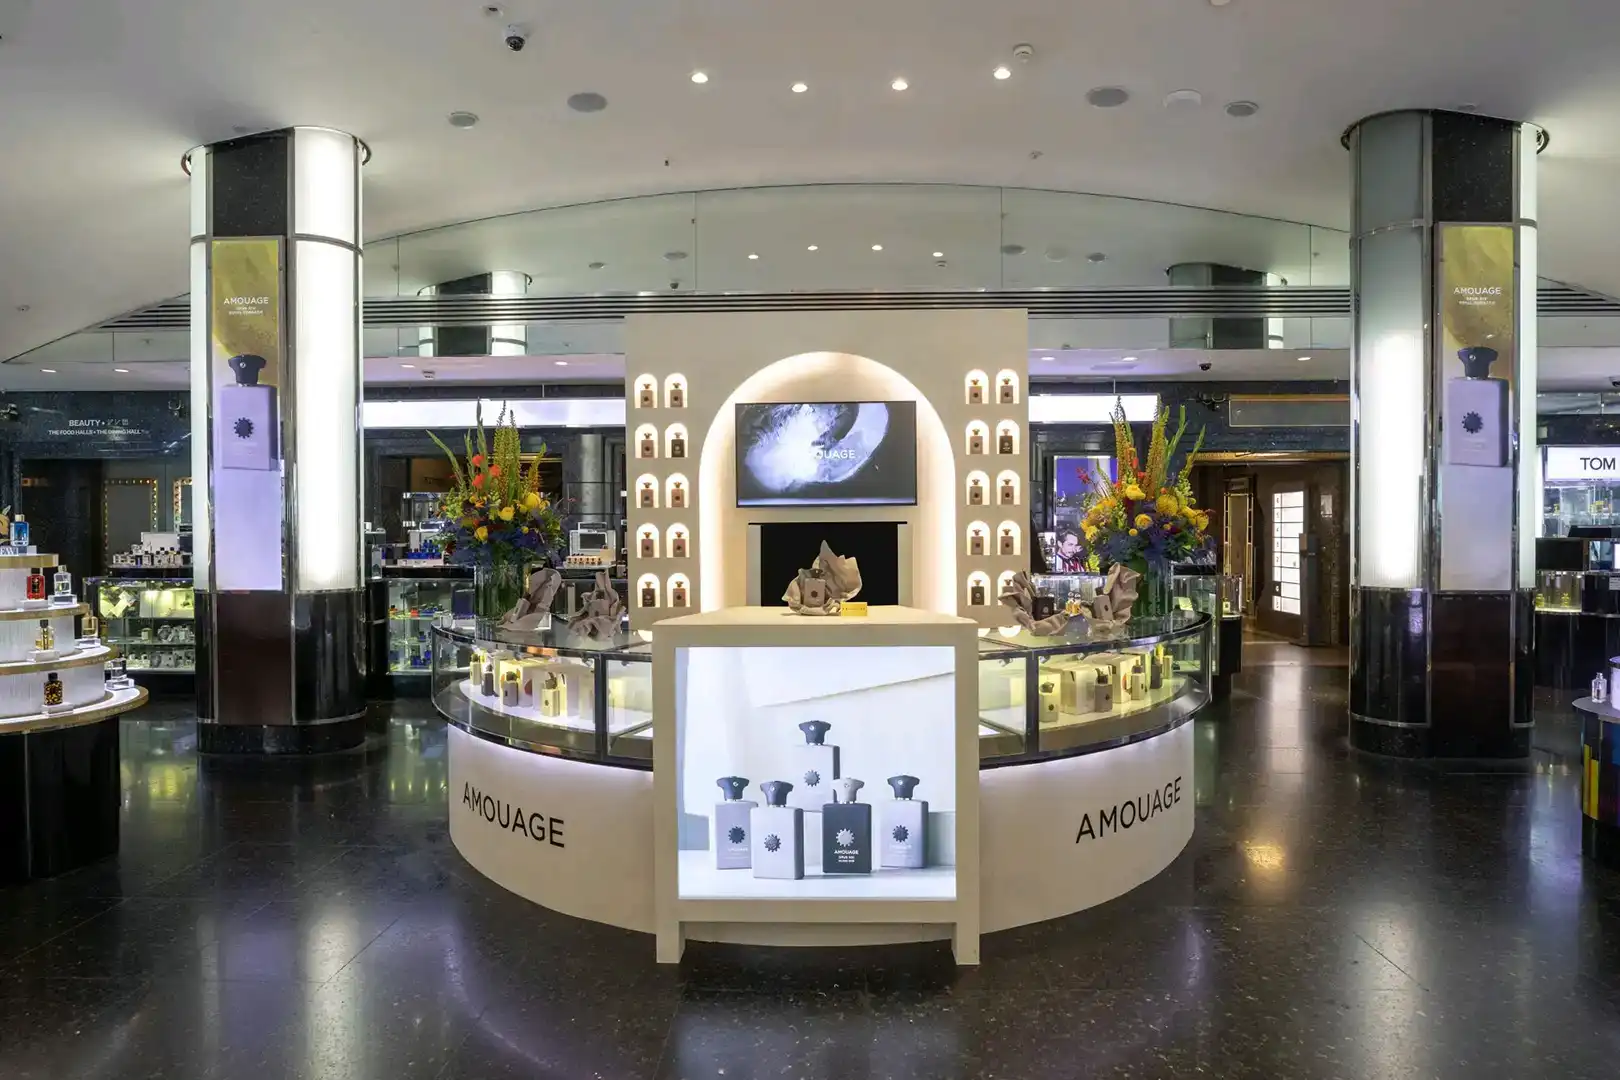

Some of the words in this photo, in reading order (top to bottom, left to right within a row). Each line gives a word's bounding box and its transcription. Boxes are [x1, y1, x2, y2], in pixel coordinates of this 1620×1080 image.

[1453, 286, 1502, 295] AMOUAGE
[223, 296, 270, 305] AMOUAGE
[68, 419, 101, 427] BEAUTY
[1579, 457, 1616, 471] TOM
[463, 781, 565, 848] AMOUAGE
[1076, 776, 1182, 844] AMOUAGE
